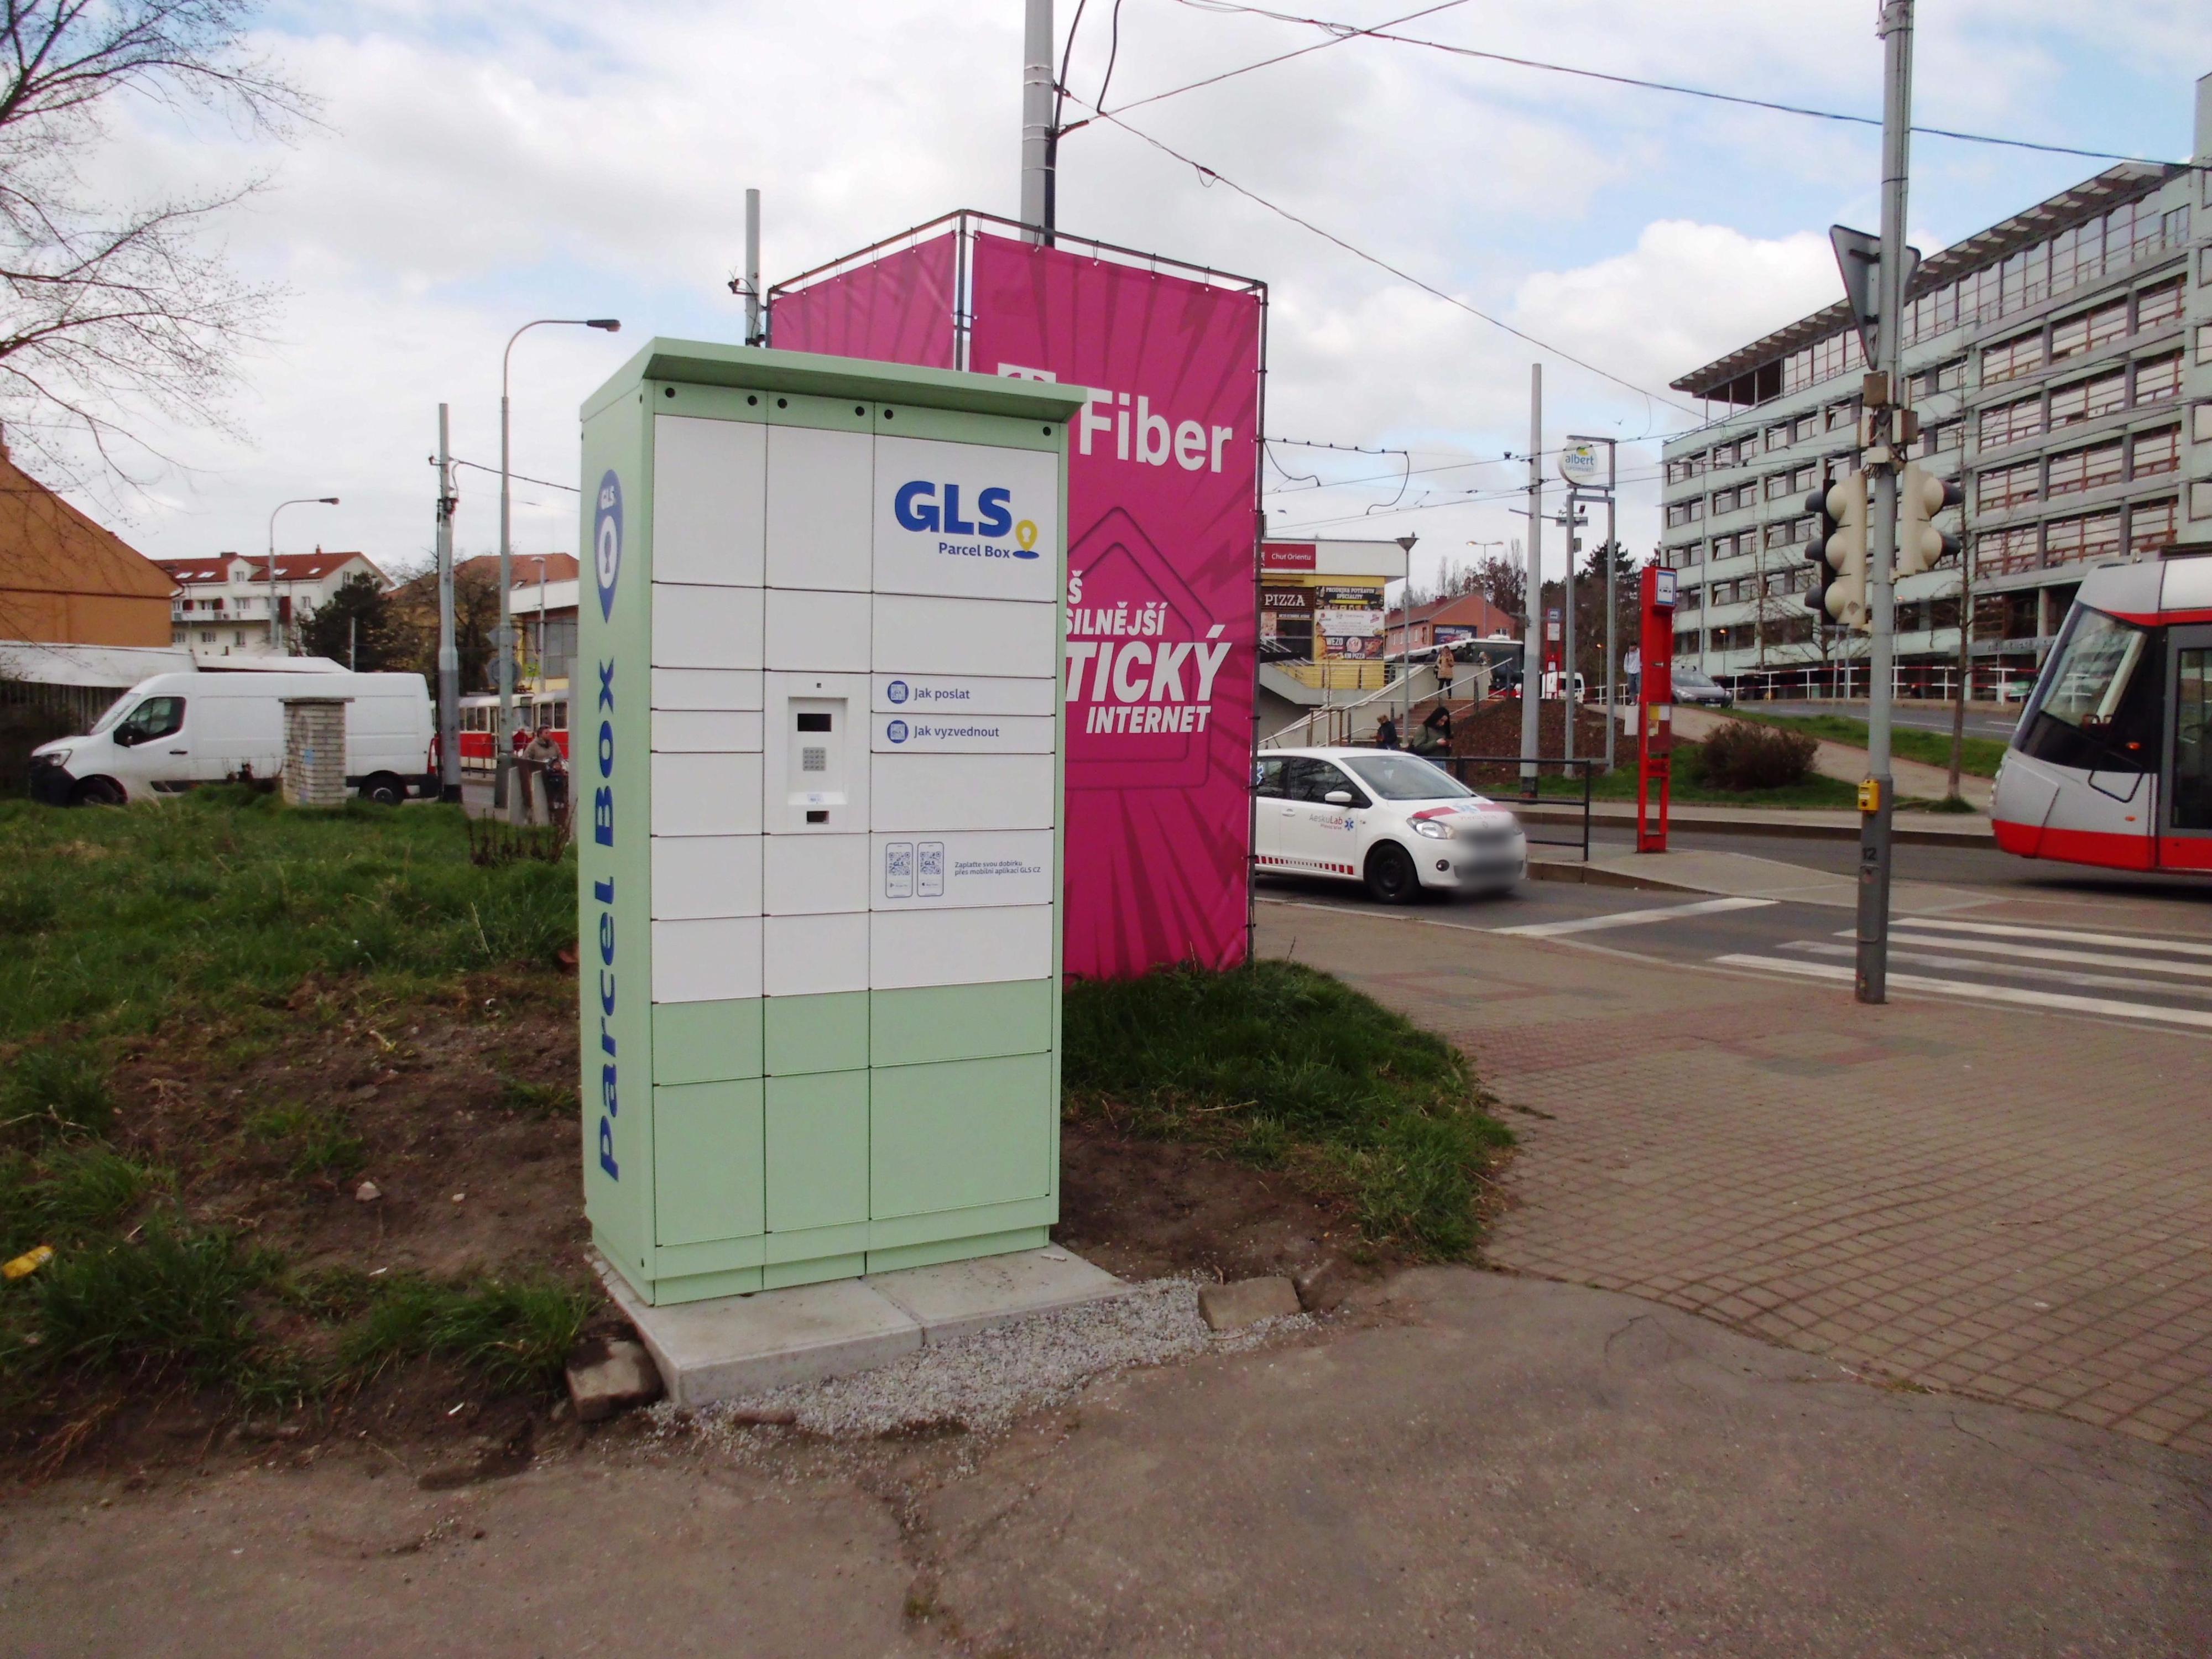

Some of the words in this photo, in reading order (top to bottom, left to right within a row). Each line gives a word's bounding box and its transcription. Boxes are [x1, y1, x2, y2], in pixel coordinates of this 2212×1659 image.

[1079, 388, 1233, 474] Fiber
[1565, 453, 1594, 466] albert
[894, 481, 1013, 538] GLS
[938, 542, 982, 557] Parcel
[984, 545, 1010, 559] Box
[1264, 593, 1306, 607] PIZZA
[1326, 637, 1344, 646] WEZO
[914, 687, 932, 701] Jak
[935, 688, 971, 702] poslat
[1086, 705, 1212, 734] INTERNET
[913, 725, 931, 739] Jak
[934, 726, 1000, 739] vyzvednout
[594, 655, 615, 848] Box
[1308, 813, 1343, 825] AeskuLab
[1861, 847, 1877, 861] 12
[594, 875, 619, 1183] Parcel
